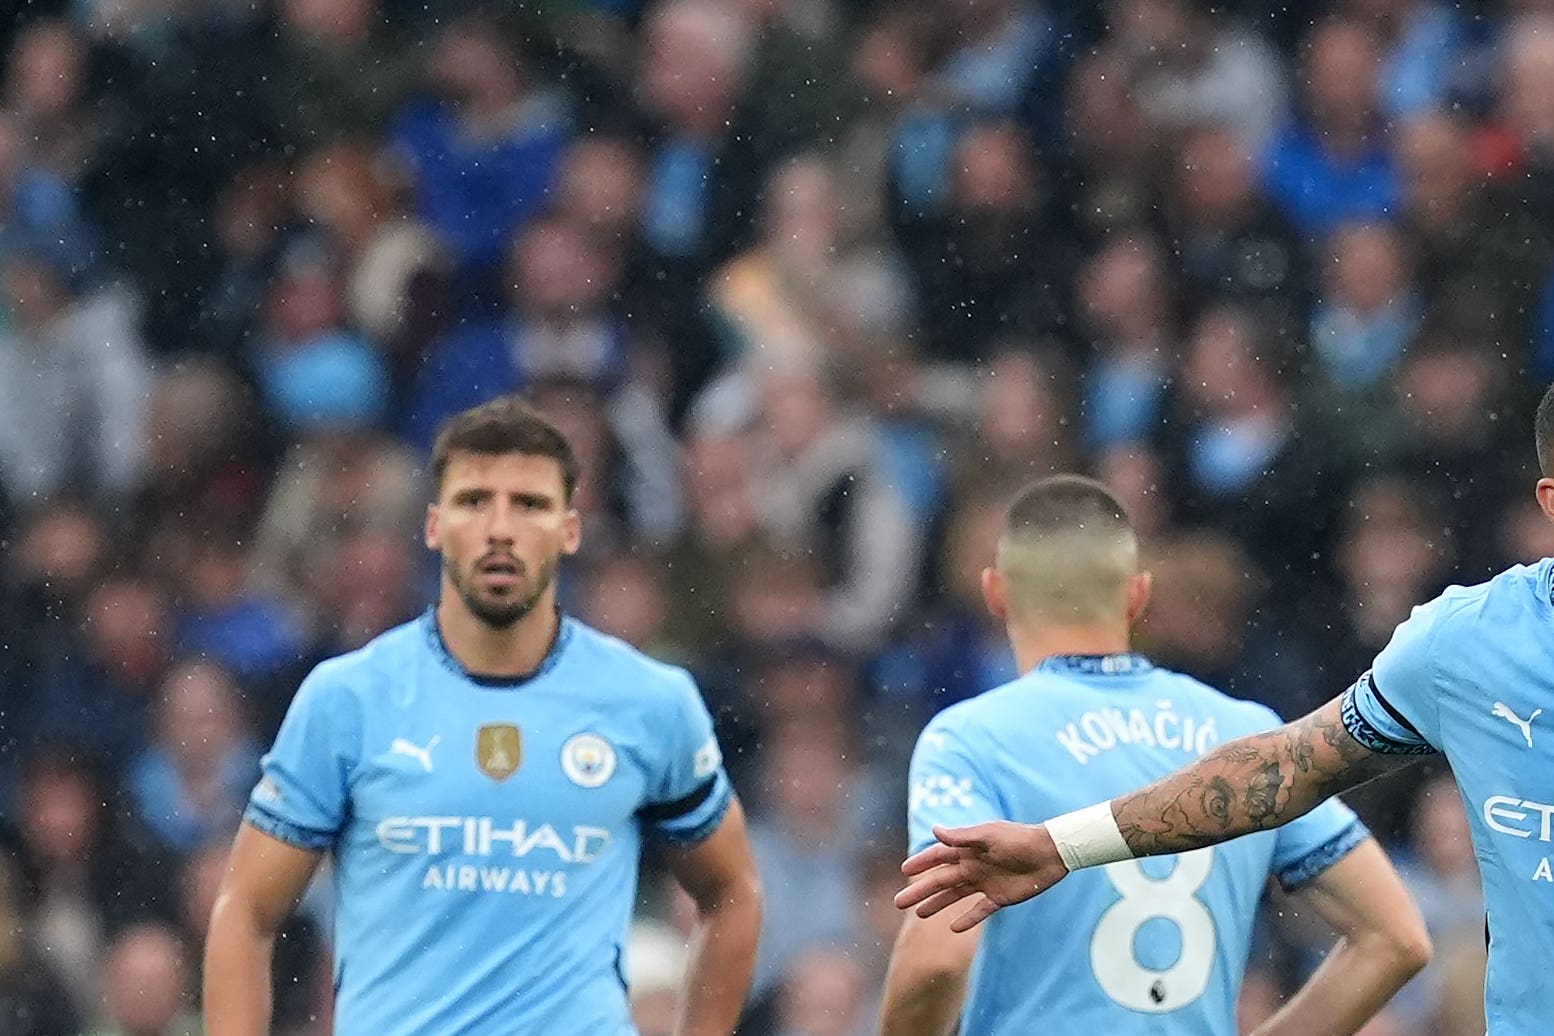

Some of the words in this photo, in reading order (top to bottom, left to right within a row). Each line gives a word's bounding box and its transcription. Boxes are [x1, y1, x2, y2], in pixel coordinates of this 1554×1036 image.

[376, 815, 612, 864] ETIHAD
[422, 863, 567, 898] AIRWAYS
[1089, 846, 1217, 1014] 8
